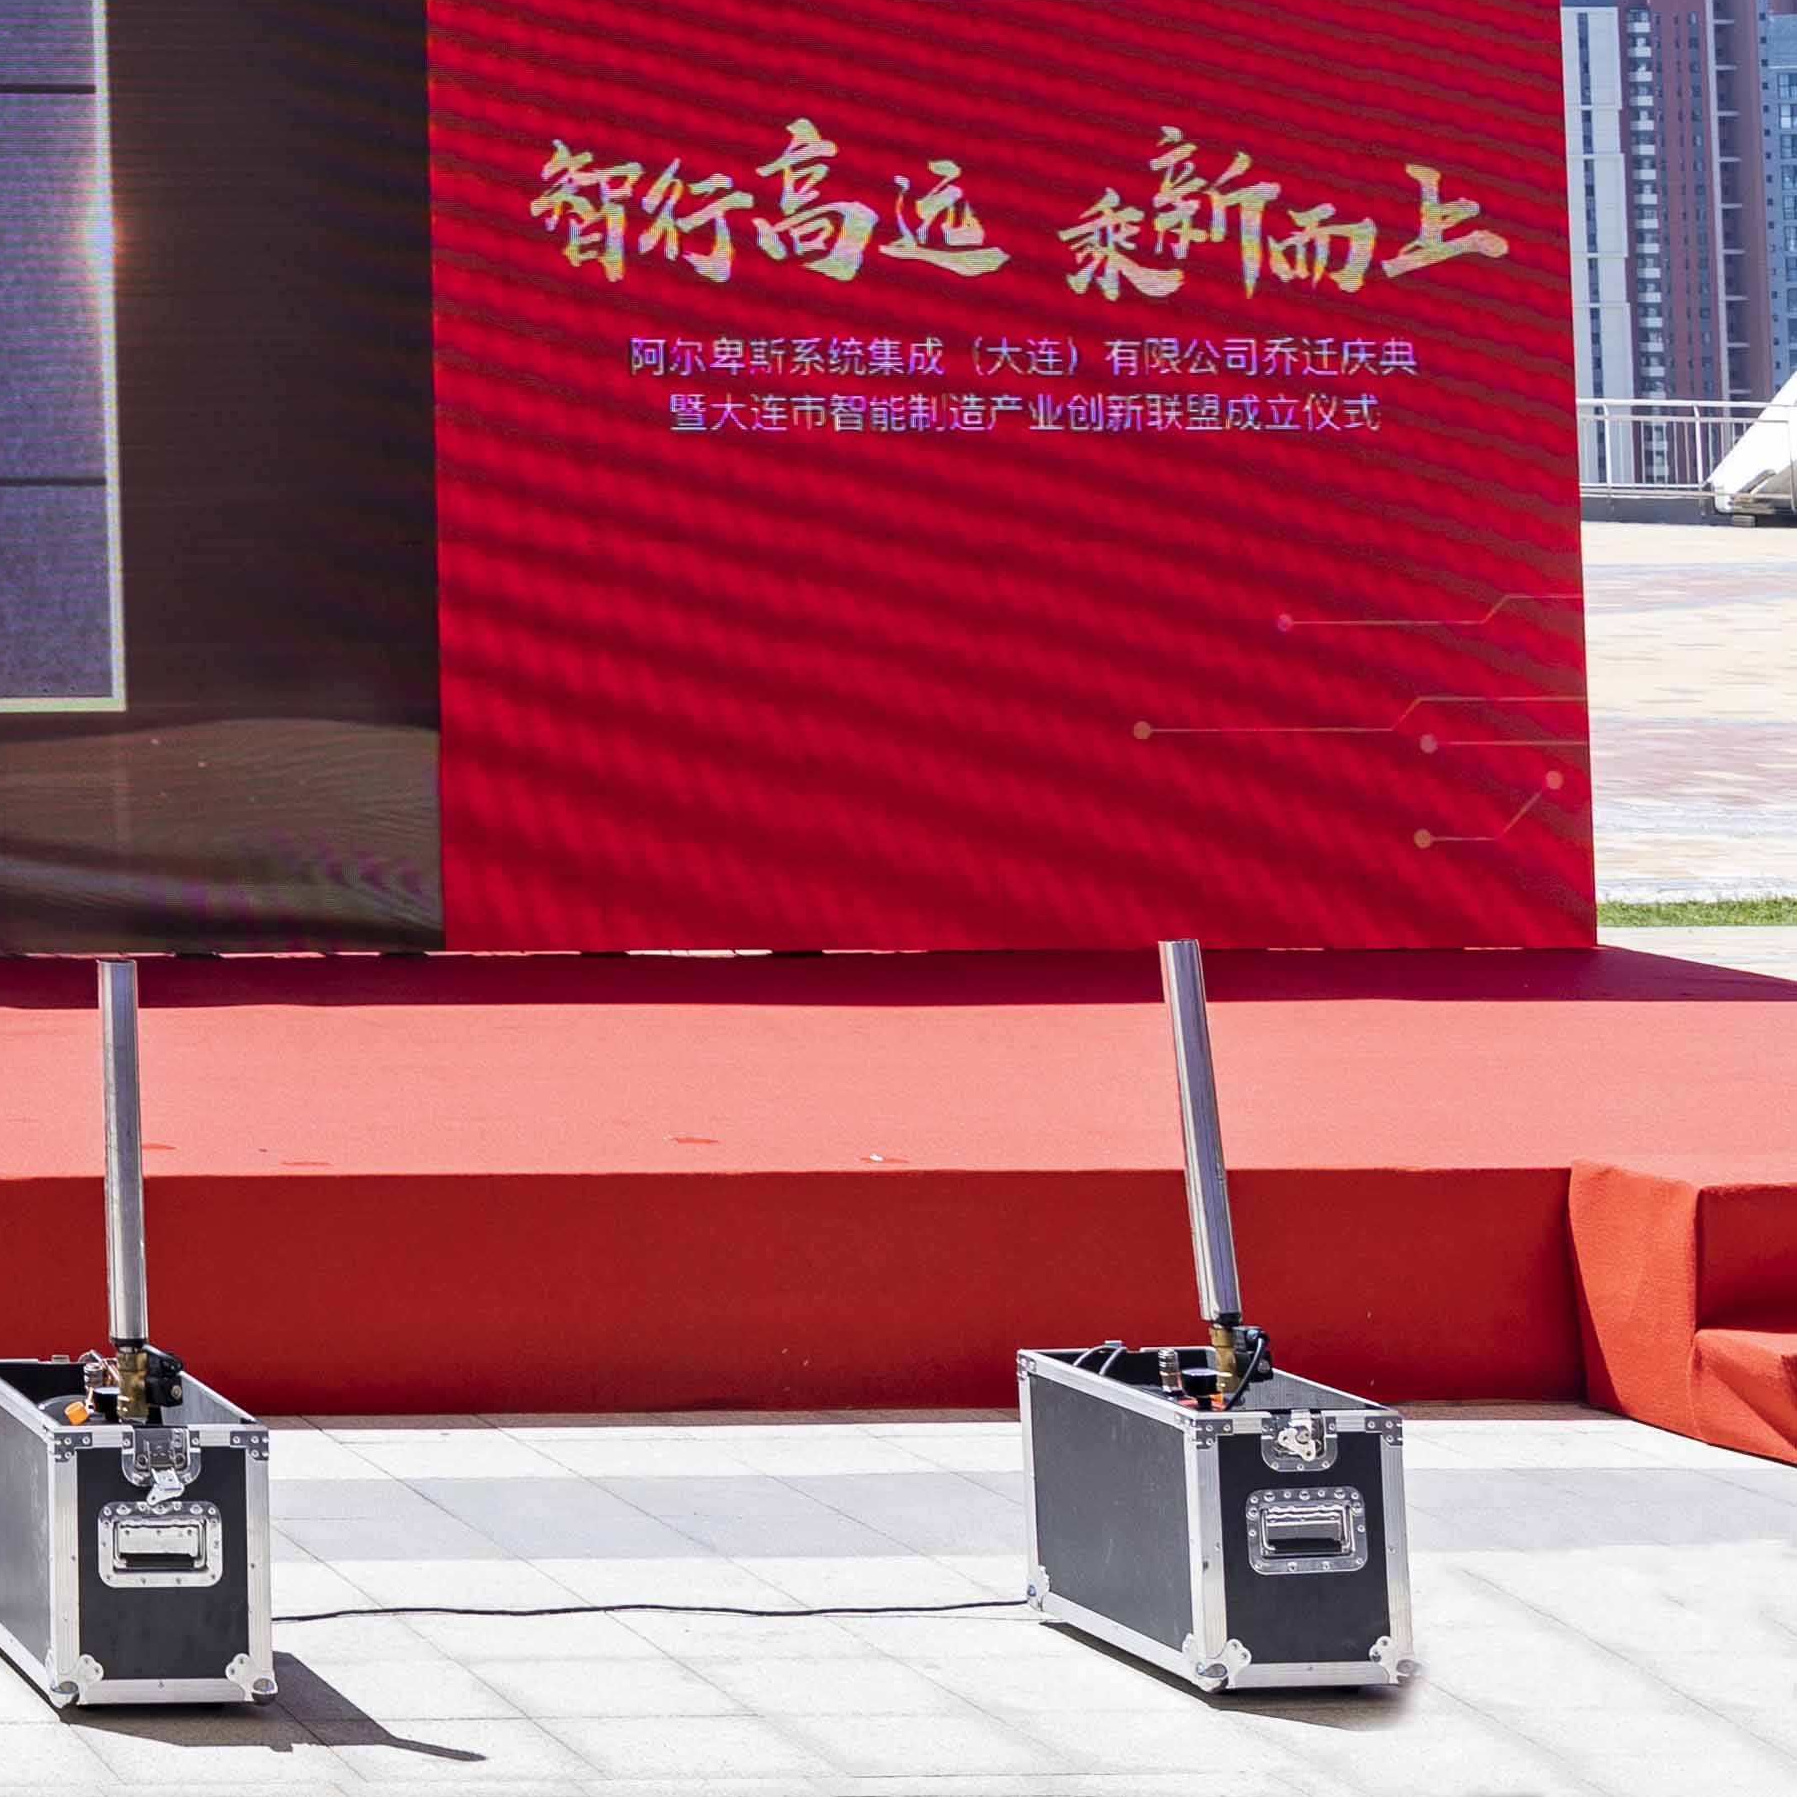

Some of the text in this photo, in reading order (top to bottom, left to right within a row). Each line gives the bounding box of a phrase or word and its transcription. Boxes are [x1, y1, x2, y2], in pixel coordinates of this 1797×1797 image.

[529, 117, 1509, 301] 智行高远 乘新而上
[669, 393, 1383, 432] 暨大连市智能制造产业创新联盟成立仪式
